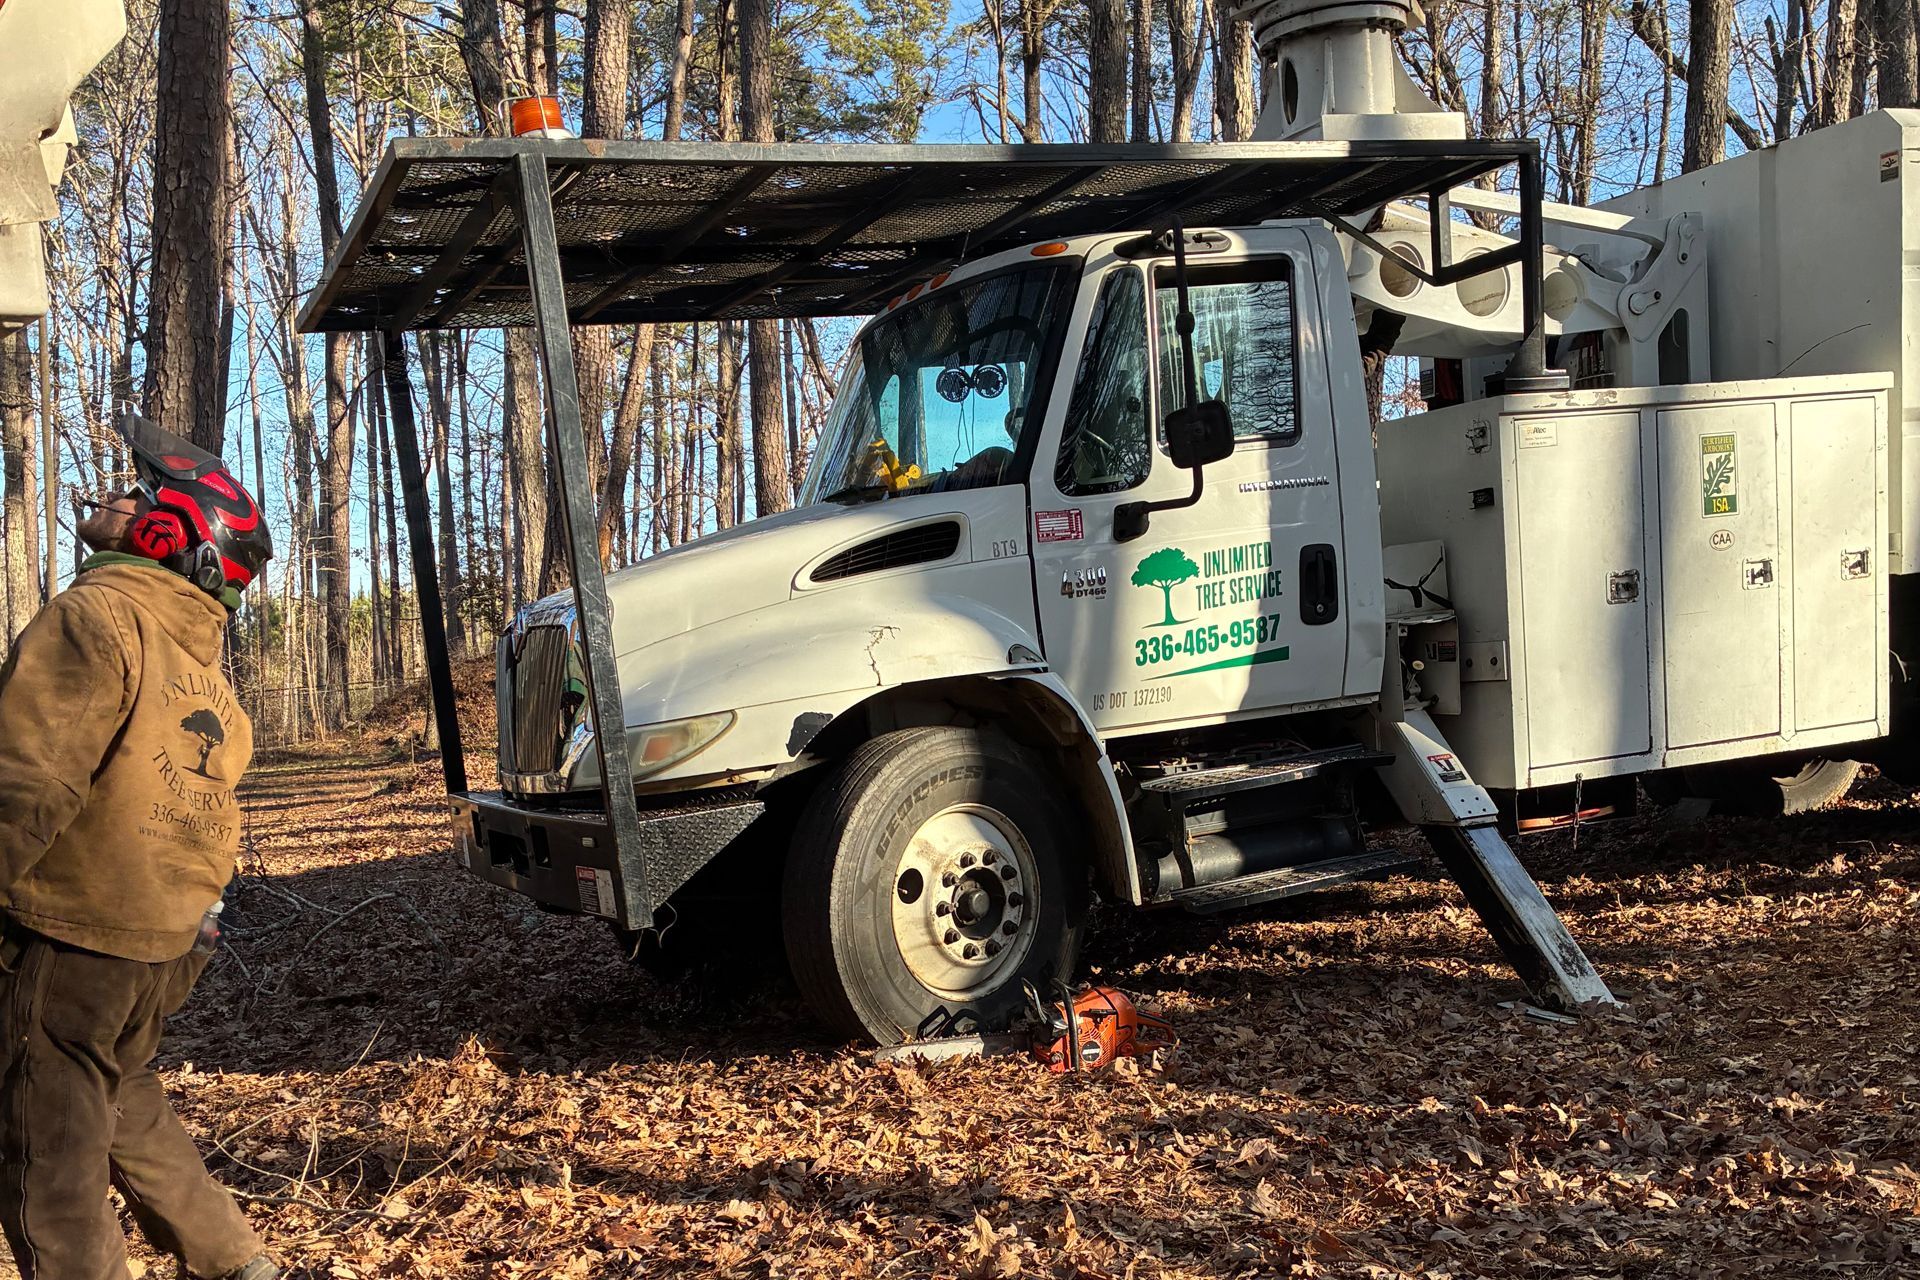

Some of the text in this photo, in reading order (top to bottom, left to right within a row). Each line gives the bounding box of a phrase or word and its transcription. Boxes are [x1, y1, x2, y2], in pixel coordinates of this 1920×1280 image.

[1703, 436, 1734, 446] CERTIFIED
[1704, 443, 1734, 454] ARBORIST
[1239, 475, 1330, 493] INTERNATIONAL
[1712, 497, 1729, 513] ISA
[992, 539, 1018, 558] BT9
[1712, 533, 1732, 545] CAA
[1203, 542, 1273, 578] UNLIMITED
[1061, 565, 1107, 599] 4300
[1195, 569, 1283, 611] TREE SERVICE
[1076, 587, 1107, 598] DT466
[161, 673, 233, 738] UNLIMITE
[1093, 694, 1105, 711] US
[1109, 691, 1127, 709] DOT
[152, 746, 186, 800] TREE
